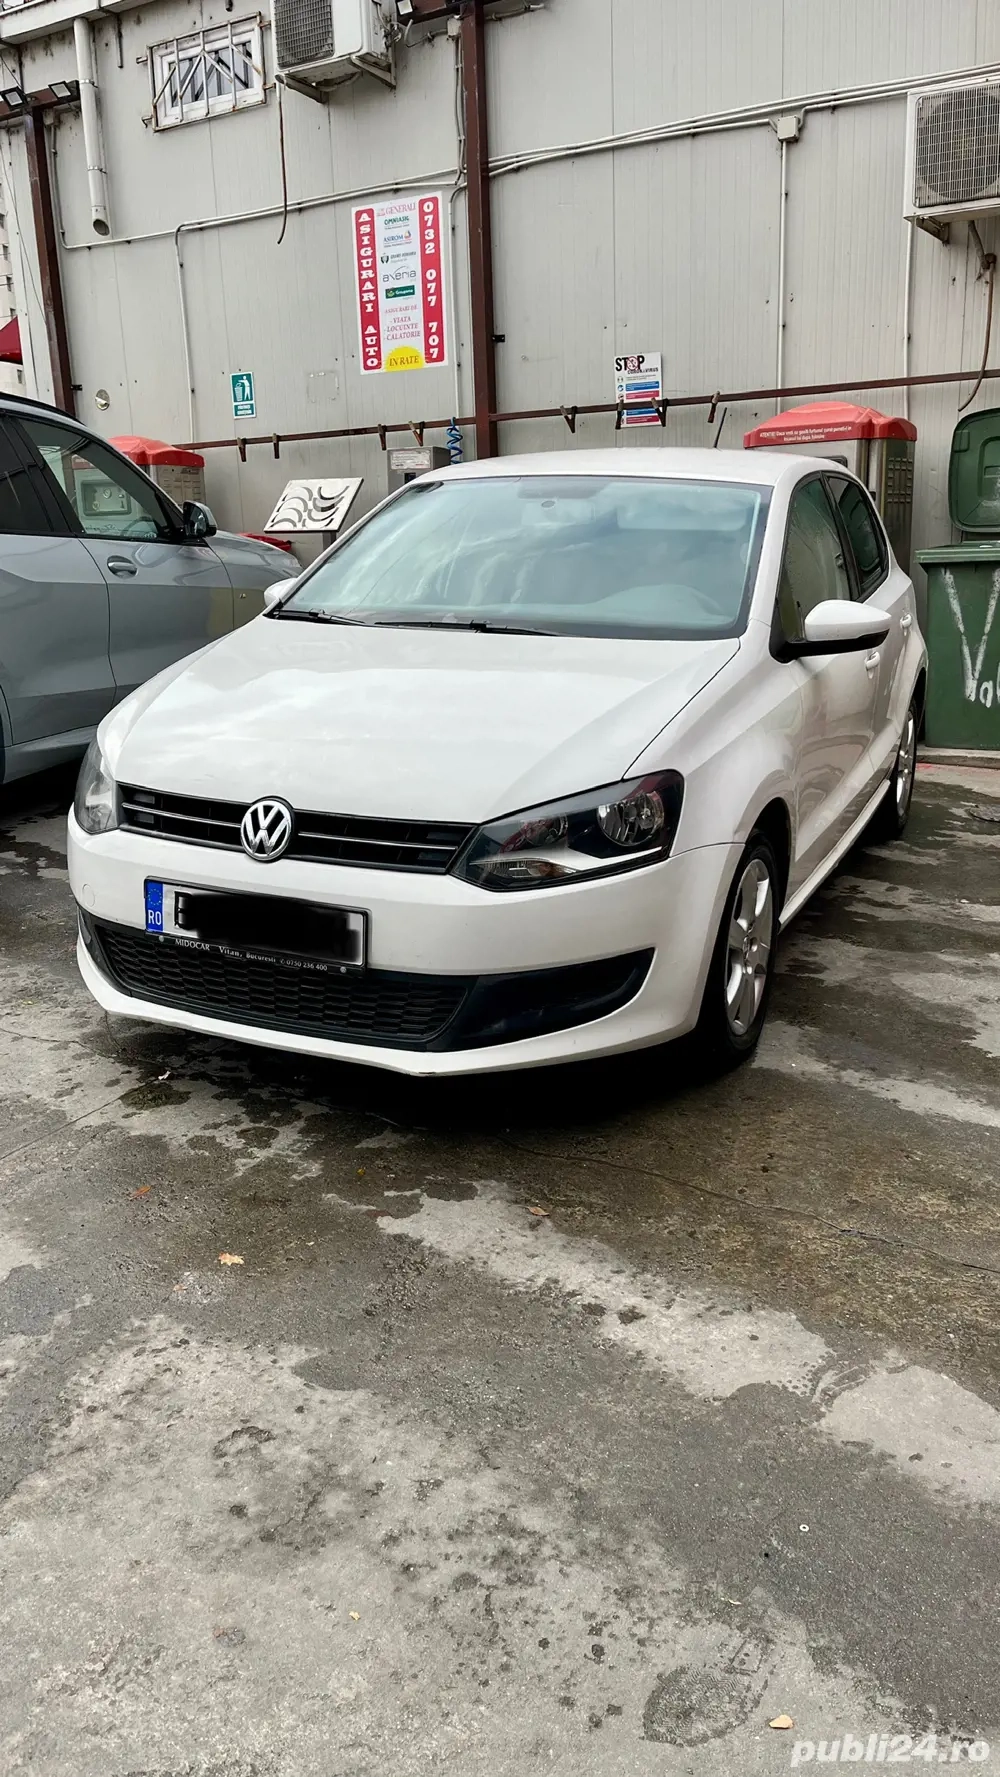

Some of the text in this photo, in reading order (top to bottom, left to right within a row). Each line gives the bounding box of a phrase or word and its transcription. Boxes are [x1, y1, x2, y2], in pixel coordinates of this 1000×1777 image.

[386, 202, 416, 215] GENERALI
[384, 216, 410, 225] OMNIASIG
[384, 234, 404, 243] ASIROM
[423, 201, 439, 359] 0732 077 707
[358, 212, 379, 367] ASIGURARI AUTO
[385, 305, 410, 313] ASIGURARI
[387, 323, 419, 332] LOCUINTE
[386, 330, 421, 341] CALATORIE
[389, 355, 420, 367] IN RATE
[615, 355, 645, 372] STOP
[148, 909, 162, 926] RO
[175, 938, 210, 951] MIDOCAR
[315, 963, 328, 971] 400
